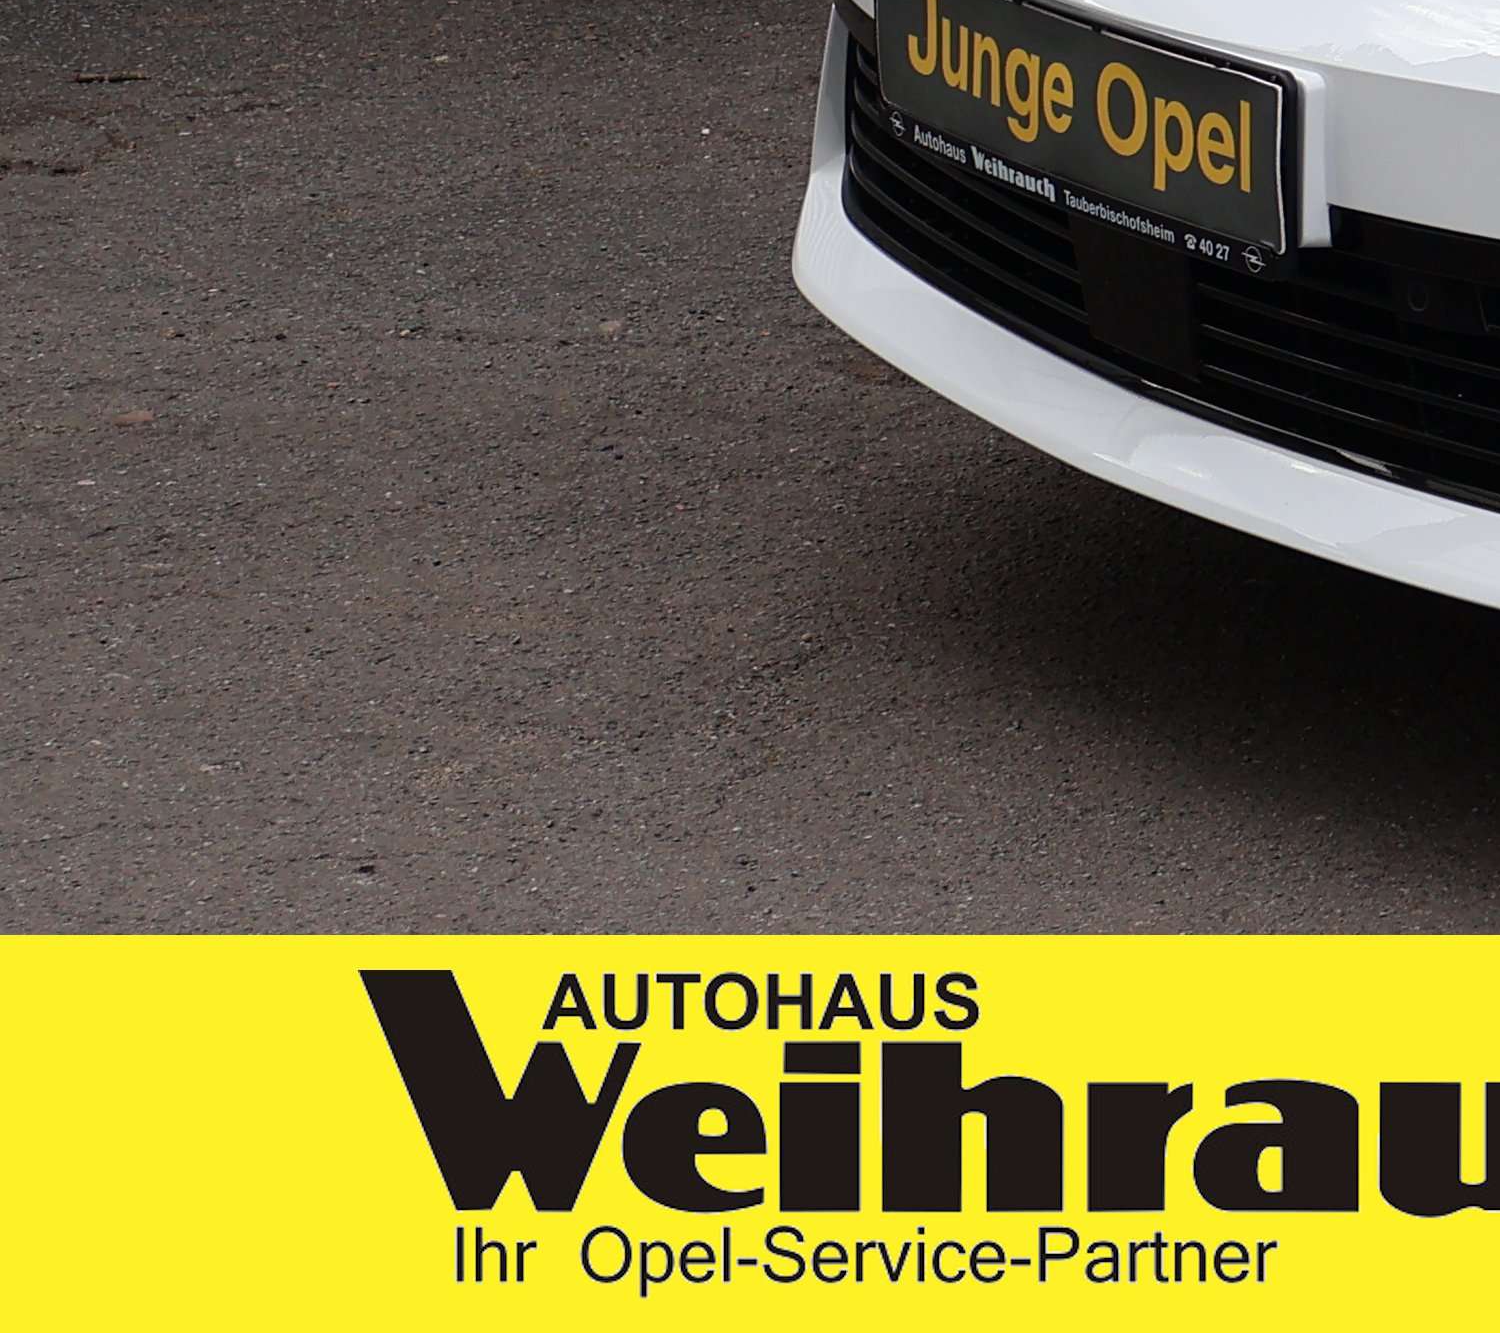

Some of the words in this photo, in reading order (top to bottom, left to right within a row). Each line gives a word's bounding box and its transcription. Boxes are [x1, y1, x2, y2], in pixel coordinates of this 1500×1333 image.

[914, 124, 966, 164] Autohaus
[971, 145, 1056, 203] Weihrauch
[1063, 189, 1175, 244] Tauberbischofsheim
[1199, 238, 1214, 257] 40
[1216, 242, 1230, 262] 27
[1096, 61, 1252, 194] Opel
